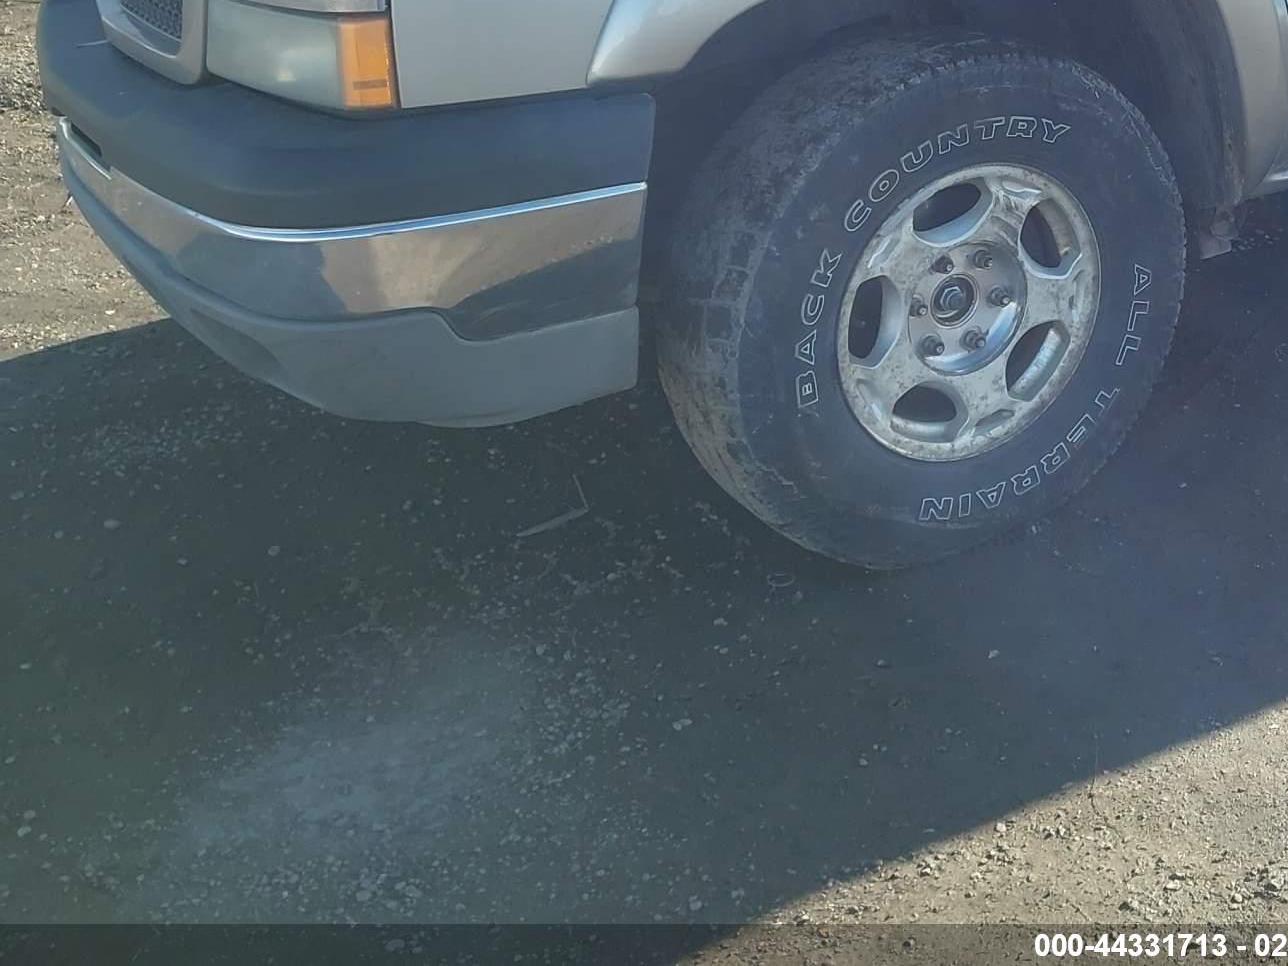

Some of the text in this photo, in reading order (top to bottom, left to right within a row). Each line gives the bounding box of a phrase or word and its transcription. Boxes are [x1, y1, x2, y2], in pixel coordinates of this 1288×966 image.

[794, 115, 1071, 408] BACK COUNTRY
[919, 264, 1152, 521] ALL TERRAIN
